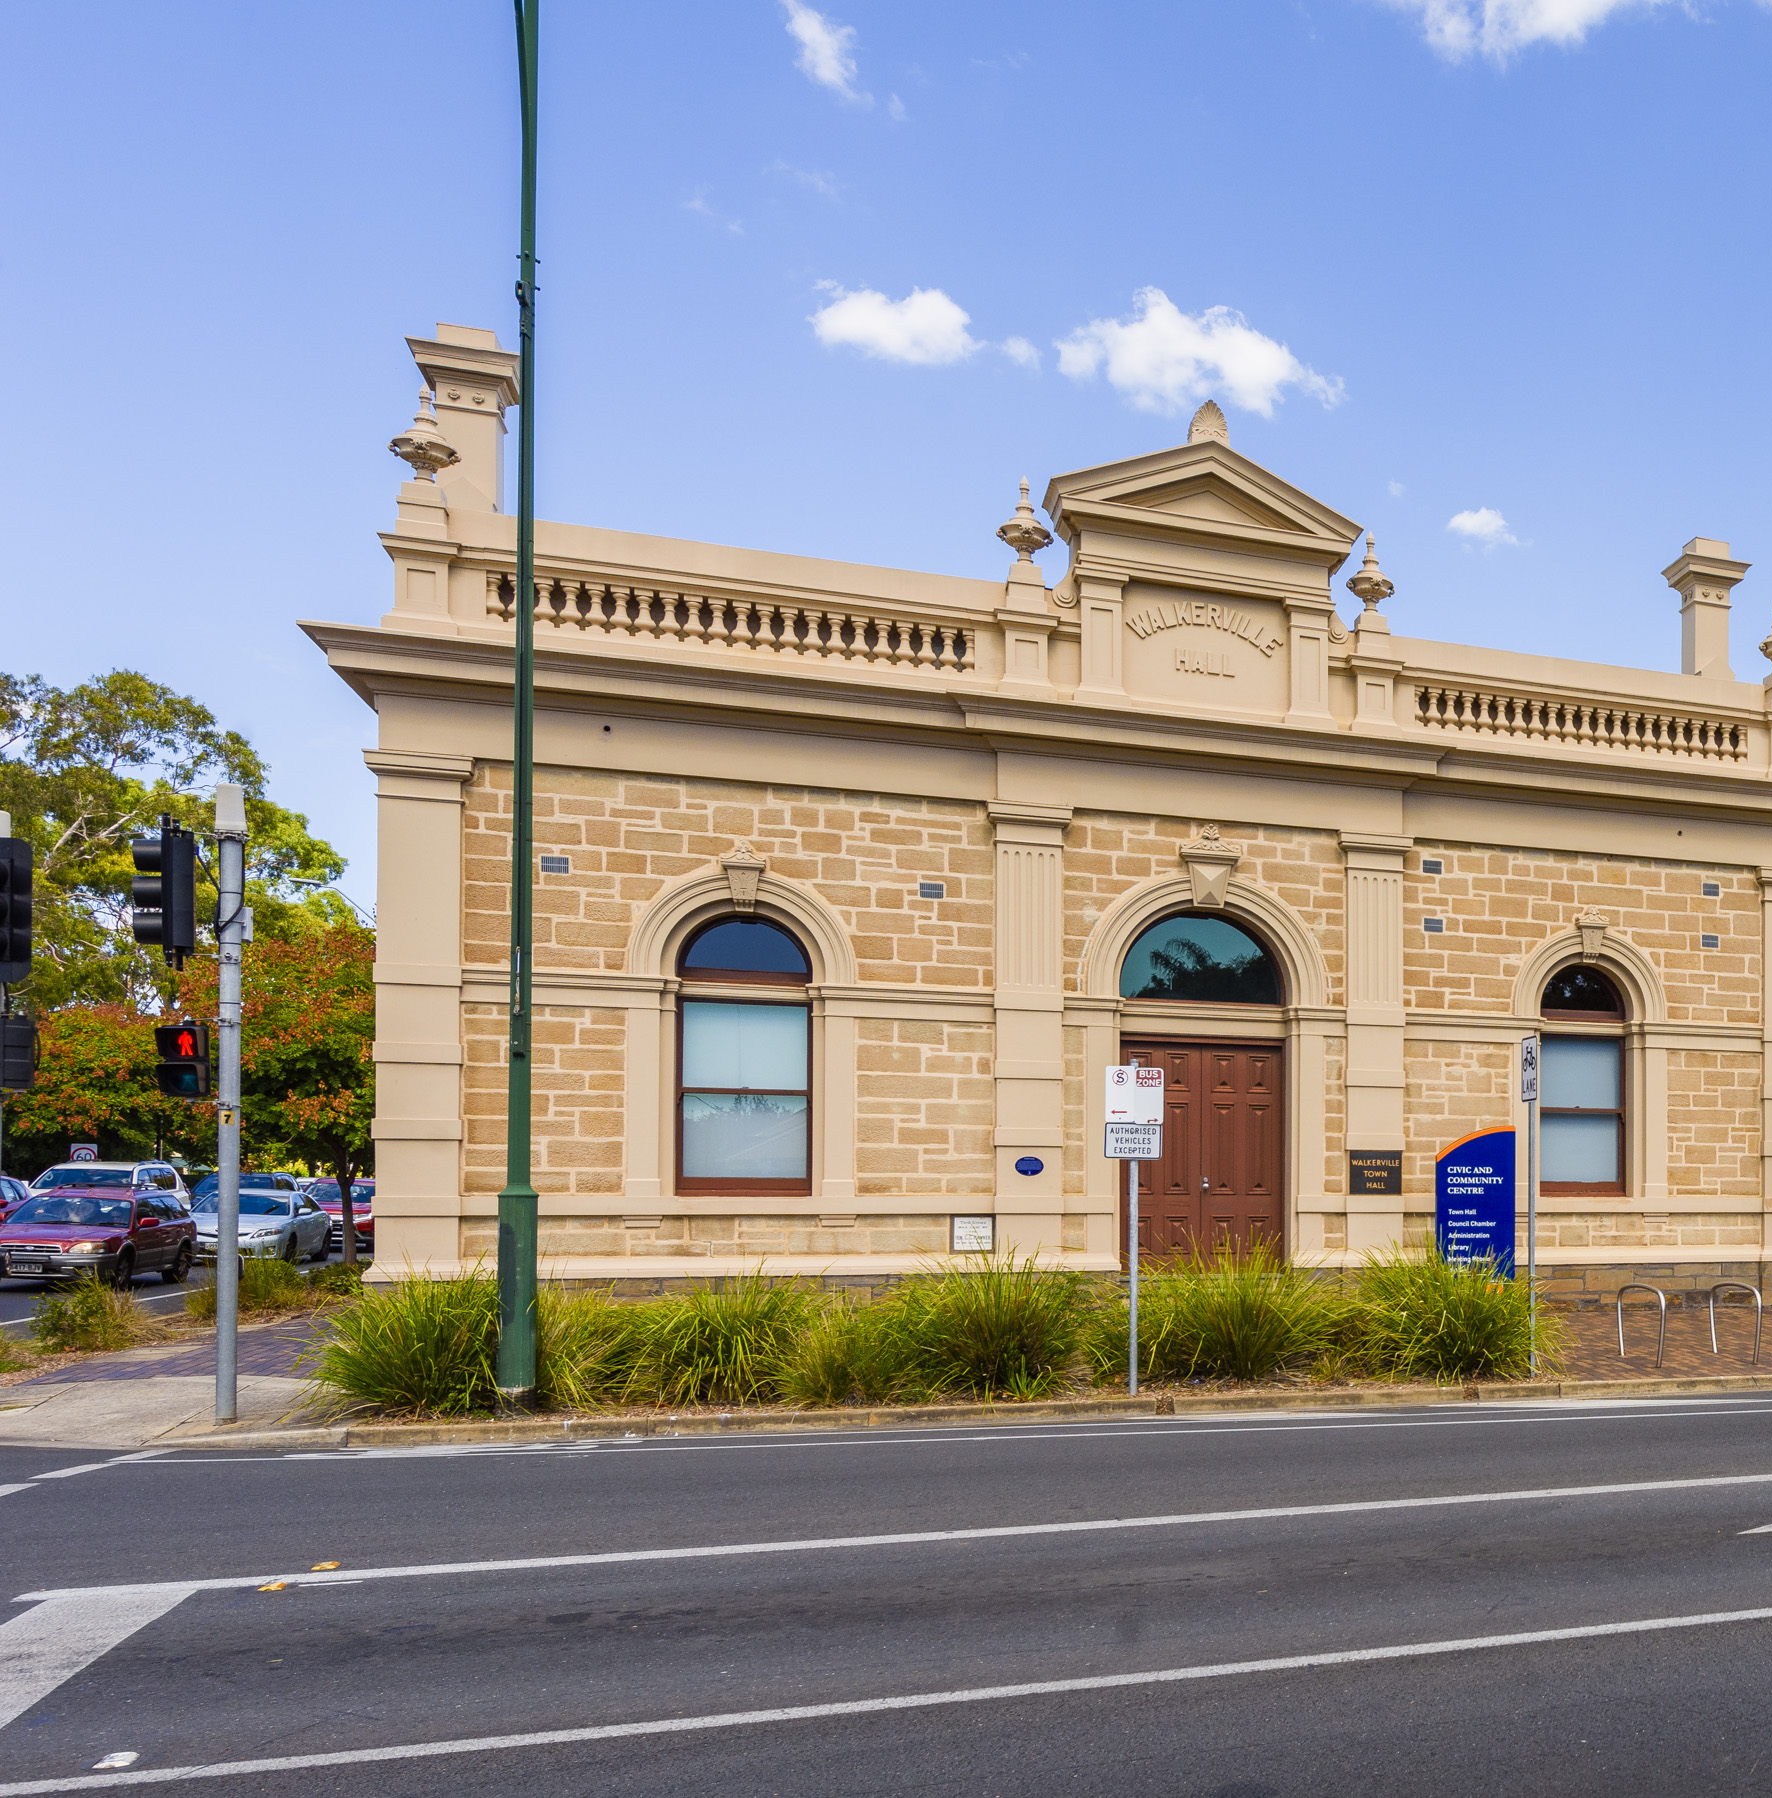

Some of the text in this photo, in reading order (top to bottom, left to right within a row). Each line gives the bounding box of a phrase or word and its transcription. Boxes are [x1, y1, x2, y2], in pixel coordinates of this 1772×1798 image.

[1126, 601, 1284, 658] WALKERVILLE
[1175, 648, 1235, 678] HALL
[1139, 1070, 1159, 1078] BUS
[1136, 1079, 1161, 1087] ZONE
[1522, 1077, 1536, 1094] LANE
[224, 1114, 231, 1124] 7
[1110, 1127, 1157, 1135] AUTHORISED
[1115, 1137, 1152, 1145] VEHICLES
[1113, 1147, 1152, 1155] EXCEPTED
[1351, 1159, 1400, 1167] WALKERVILLE
[1363, 1170, 1388, 1178] TOWN
[1447, 1166, 1493, 1174] CIVIC AND
[1447, 1176, 1504, 1184] COMMUNITY
[1447, 1187, 1484, 1195] CENTRE
[1448, 1244, 1469, 1252] Library
